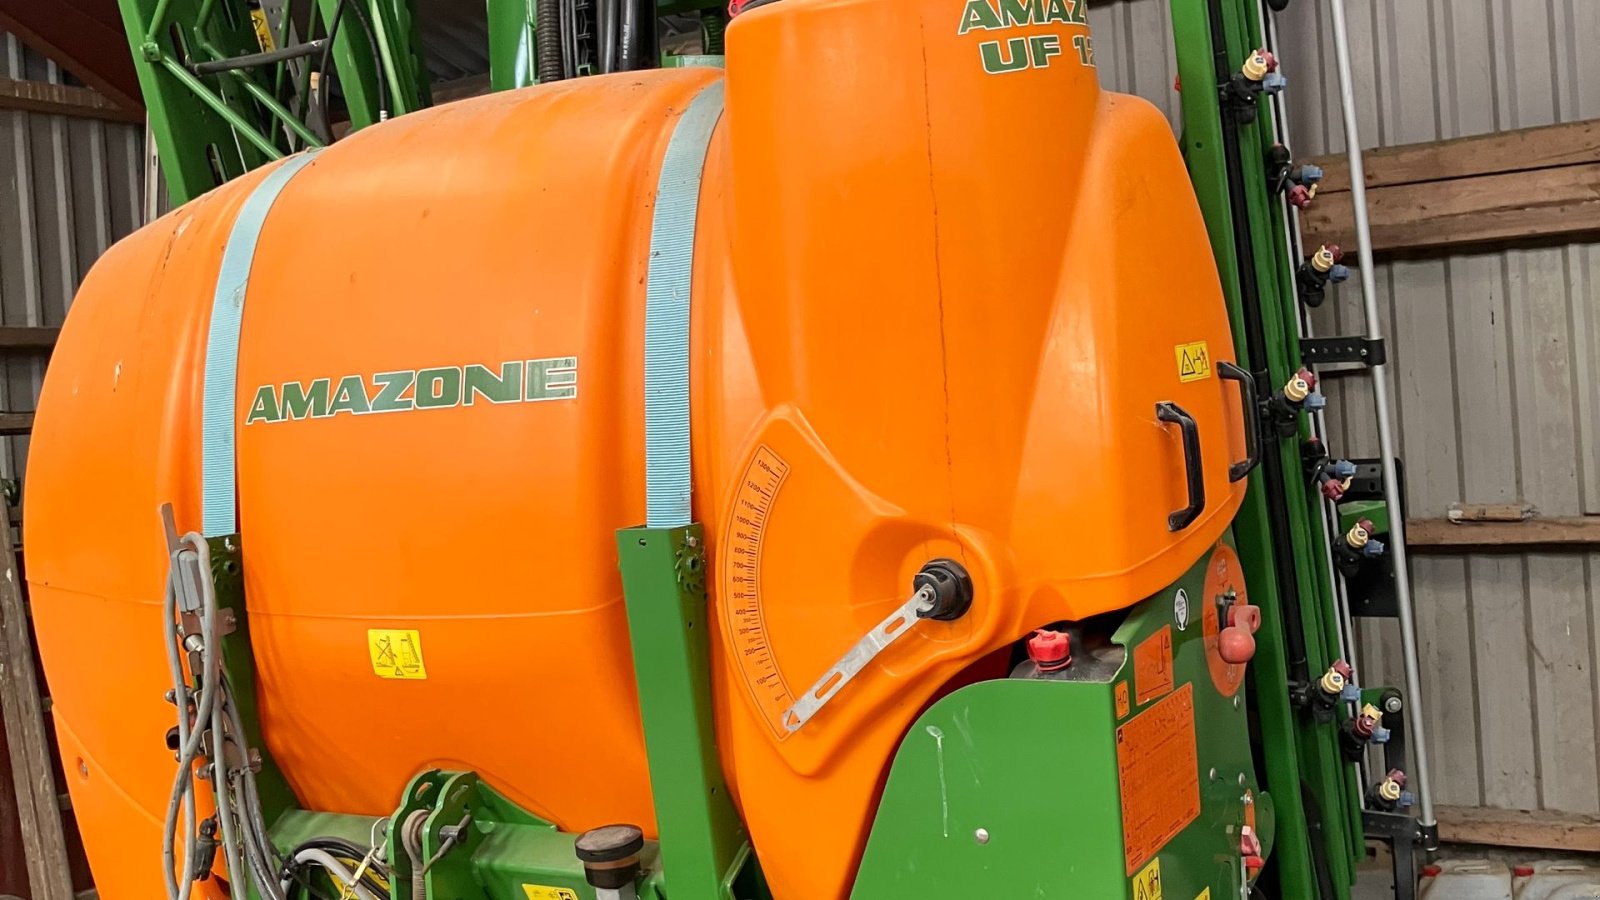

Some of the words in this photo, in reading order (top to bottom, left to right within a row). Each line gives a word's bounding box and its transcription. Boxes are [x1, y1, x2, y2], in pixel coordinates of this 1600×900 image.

[979, 35, 1062, 74] UF
[245, 357, 578, 425] AMAZONE
[758, 459, 771, 472] 1300
[748, 480, 761, 493] 1200
